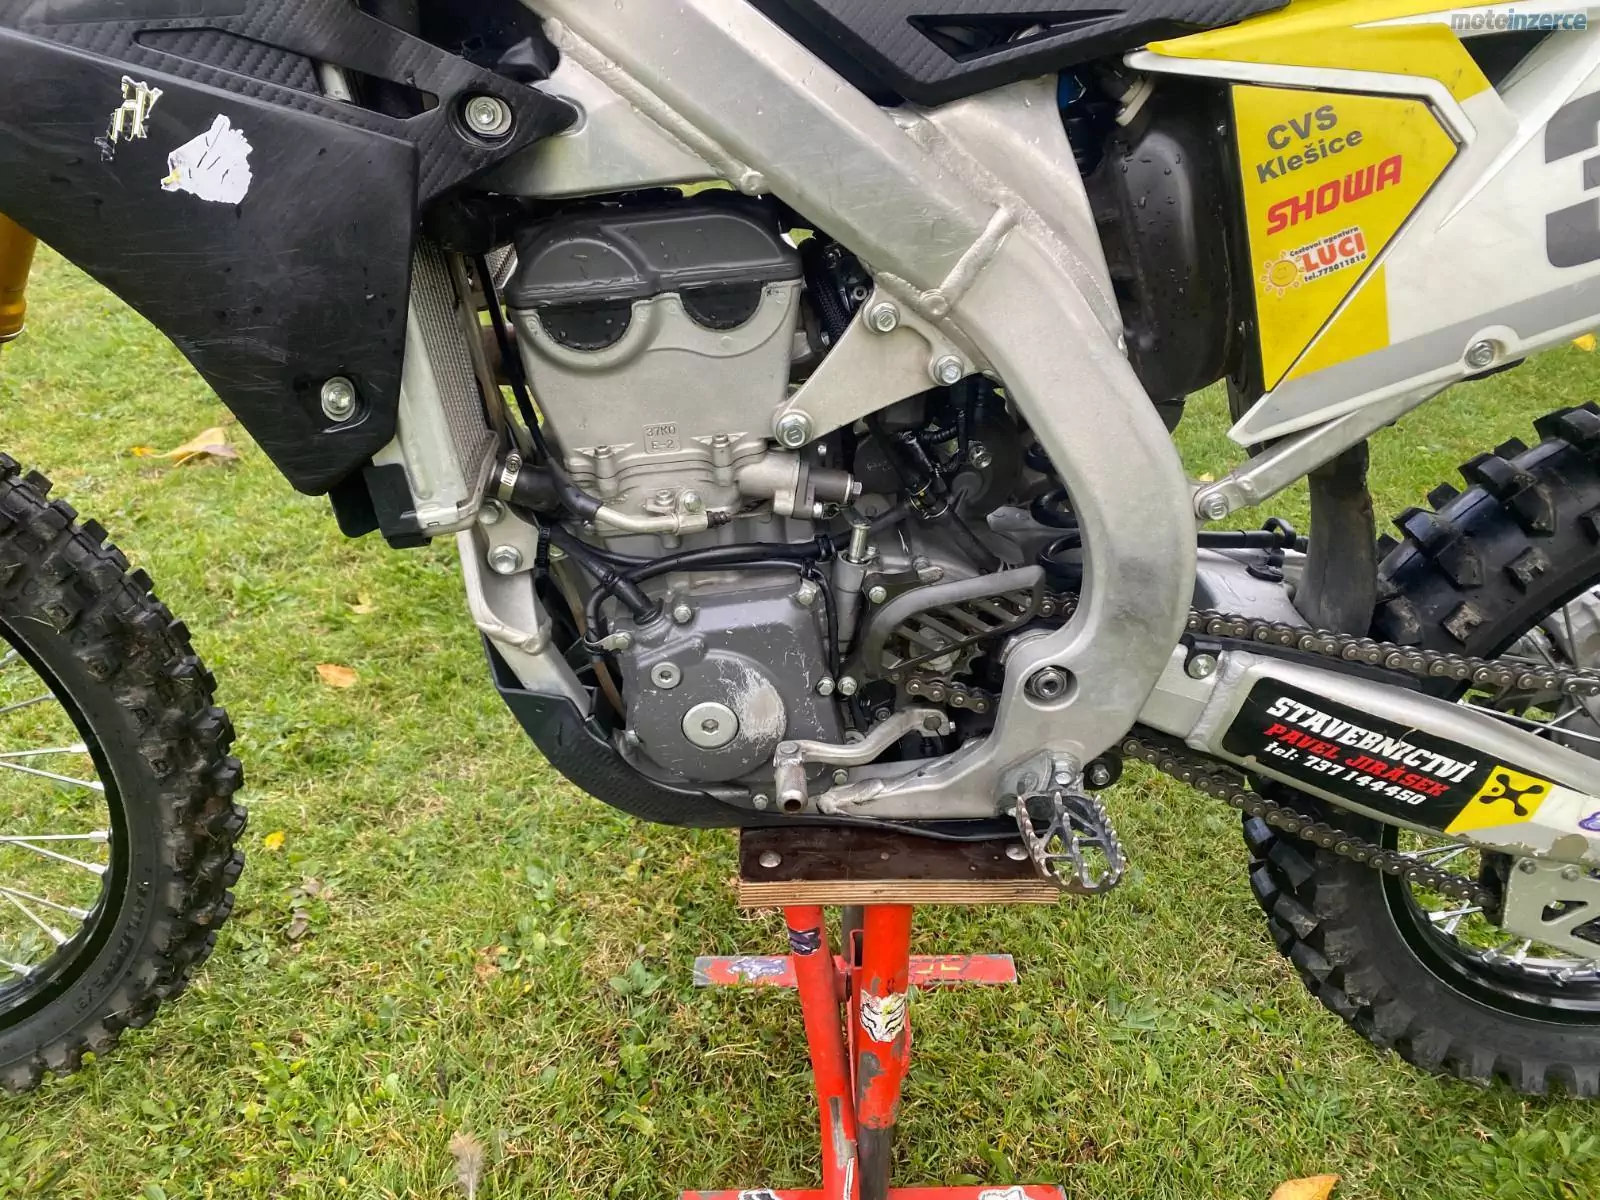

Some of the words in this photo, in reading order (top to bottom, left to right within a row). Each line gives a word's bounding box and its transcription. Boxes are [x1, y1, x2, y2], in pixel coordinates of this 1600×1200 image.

[1267, 104, 1338, 150] CVS
[1256, 130, 1363, 184] Klešice
[1267, 154, 1403, 236] SHOWA
[1302, 232, 1365, 273] LUCI
[1263, 723, 1341, 759] PAVEL
[1266, 697, 1478, 783] STAVEBNICTVÍ
[1263, 741, 1299, 761] tel:
[1303, 755, 1346, 777] 737
[1342, 771, 1427, 805] 144450
[1345, 755, 1451, 797] JIRÁSEK
